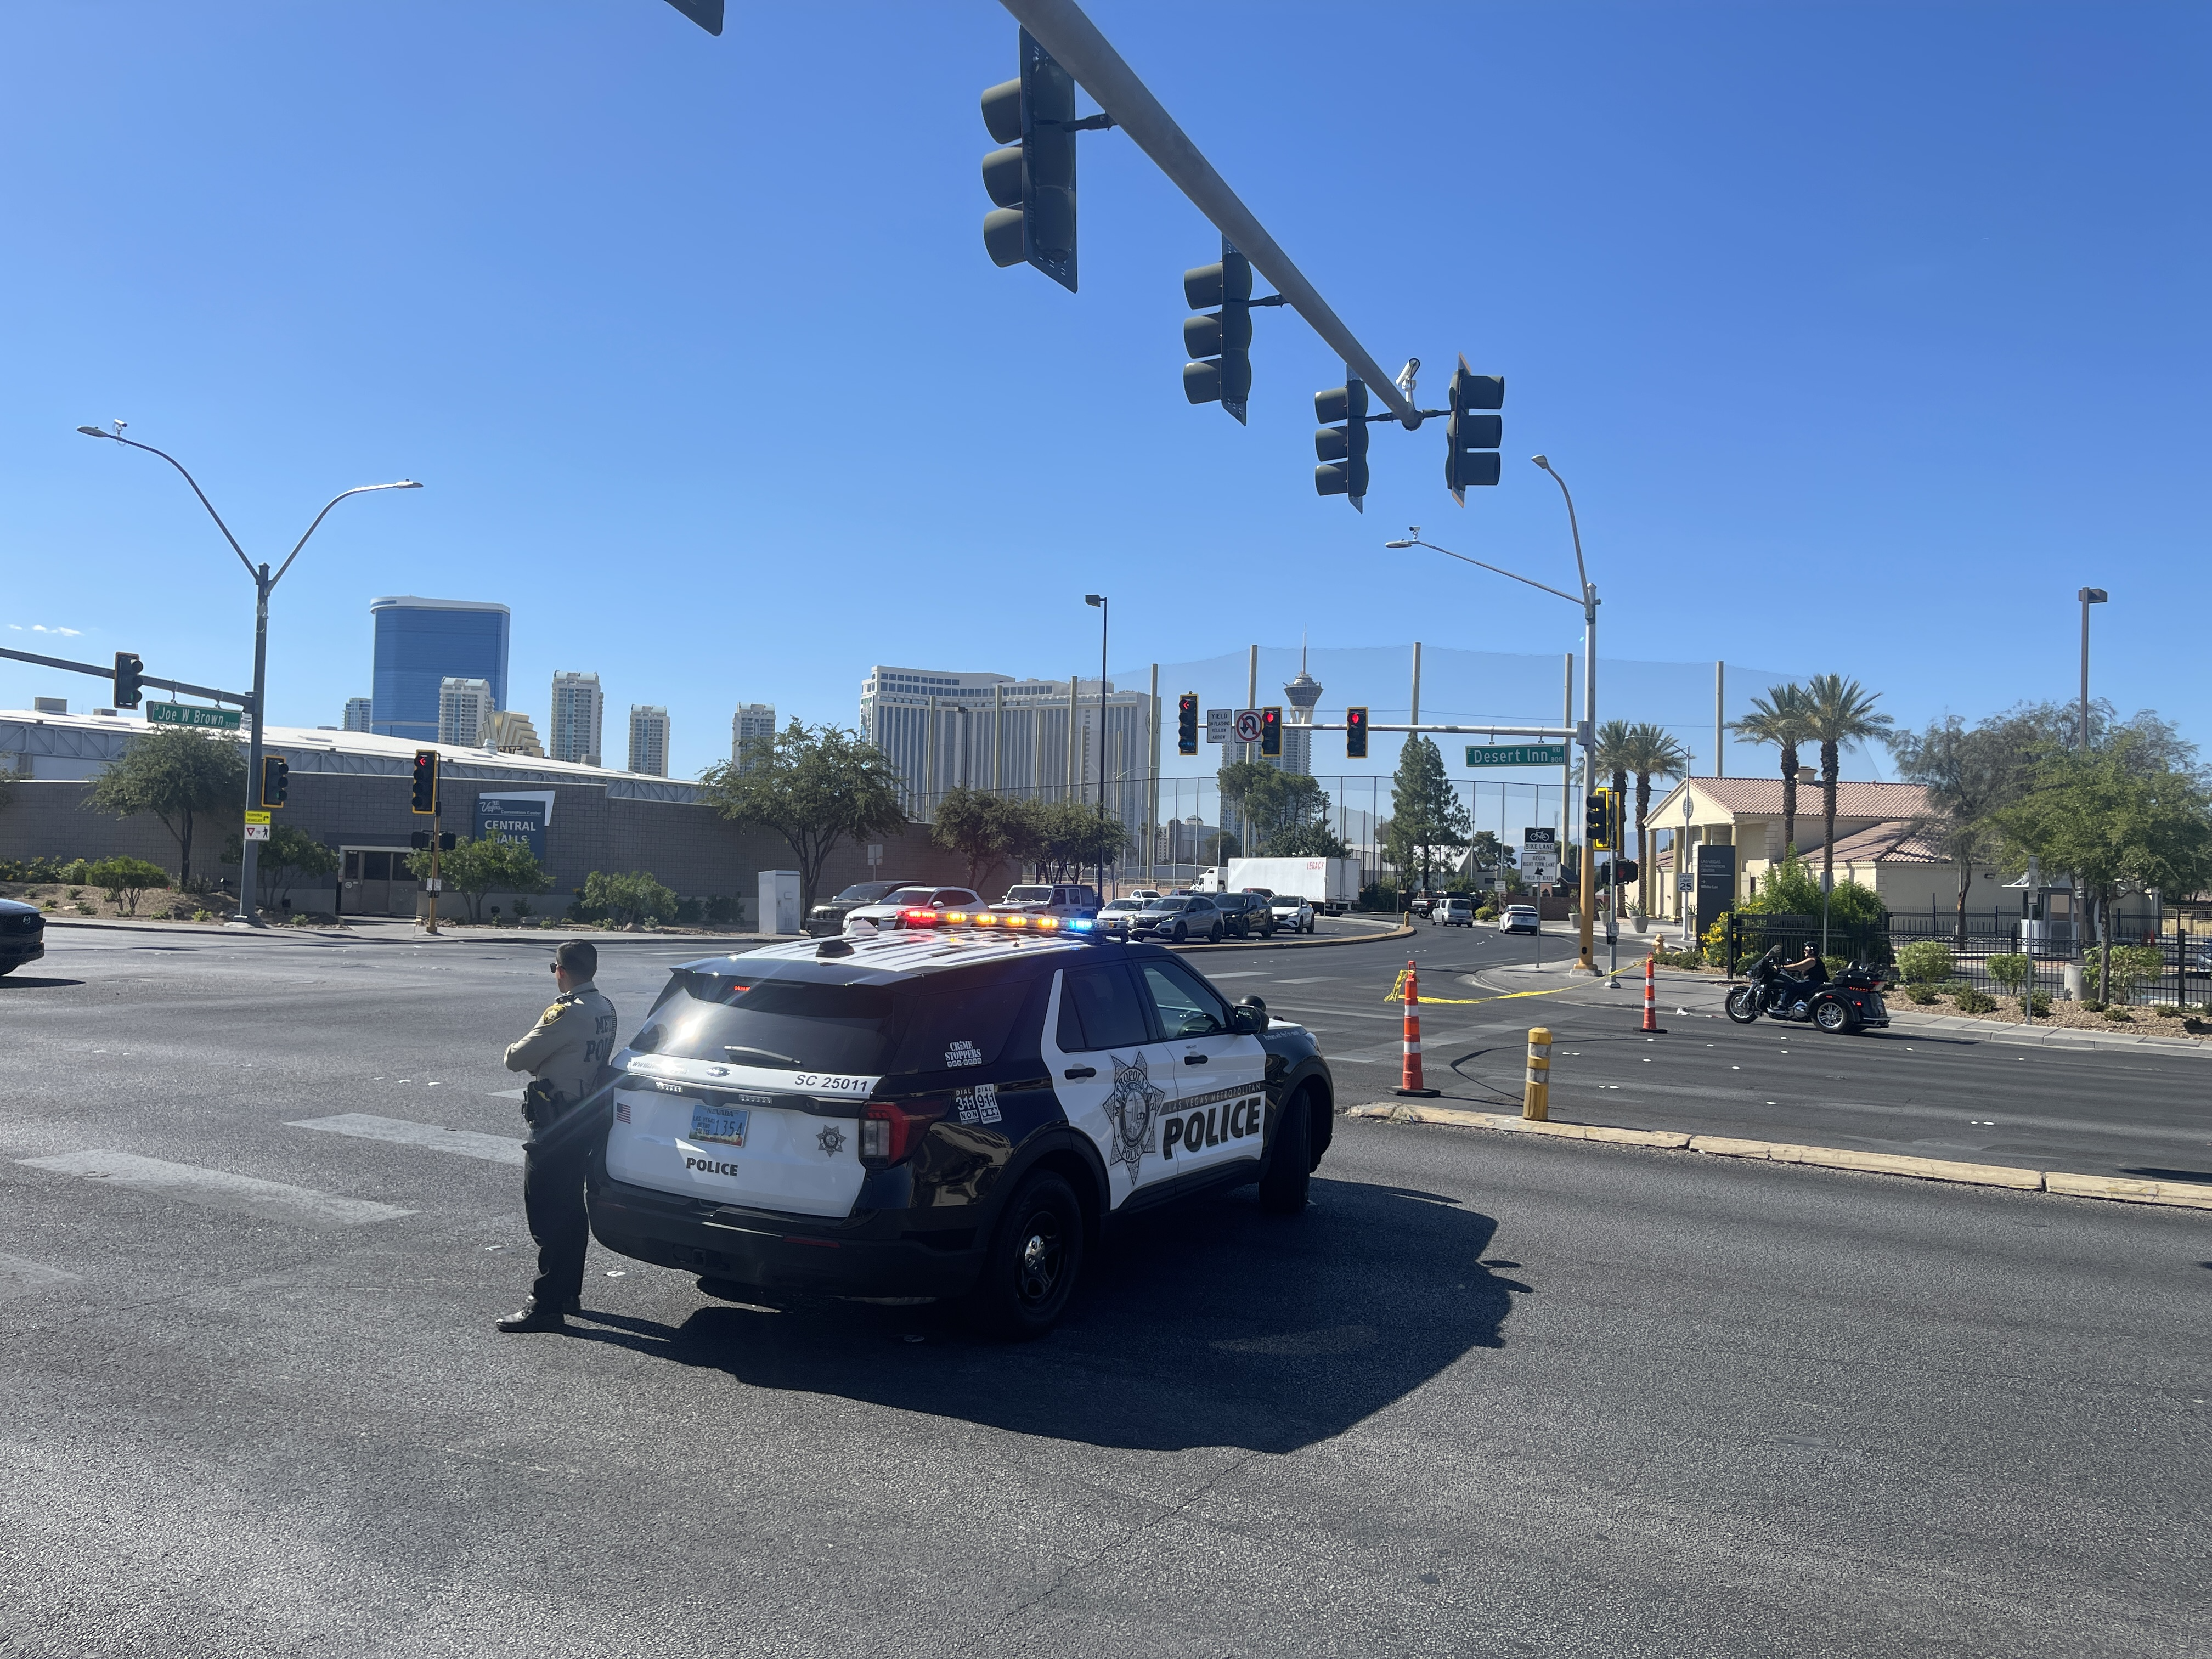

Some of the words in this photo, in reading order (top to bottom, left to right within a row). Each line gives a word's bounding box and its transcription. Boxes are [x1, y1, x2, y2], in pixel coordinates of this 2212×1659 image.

[159, 706, 177, 721] Joe
[182, 708, 190, 723] W
[193, 710, 223, 725] Brown
[1474, 749, 1521, 763] Desert
[1527, 748, 1548, 763] Inn
[479, 801, 503, 813] Vegas
[484, 820, 536, 831] CENTRAL
[1306, 861, 1324, 870] LEGACY
[950, 1040, 974, 1051] CRIME
[945, 1048, 981, 1061] STOPPERS
[794, 1074, 817, 1086] SC
[821, 1077, 868, 1092] 25011
[956, 1088, 972, 1096] DIAL
[1115, 1069, 1156, 1118] METROPOLITAN
[1169, 1101, 1182, 1112] LAS
[1185, 1096, 1207, 1108] VEGAS
[1211, 1082, 1261, 1102] METROPOLITAN
[707, 1108, 733, 1117] NEVADA
[961, 1111, 978, 1120] NON
[713, 1119, 742, 1139] 1354
[1163, 1096, 1261, 1161] POLICE
[1122, 1141, 1145, 1160] POLICE
[686, 1157, 738, 1177] POLICE
